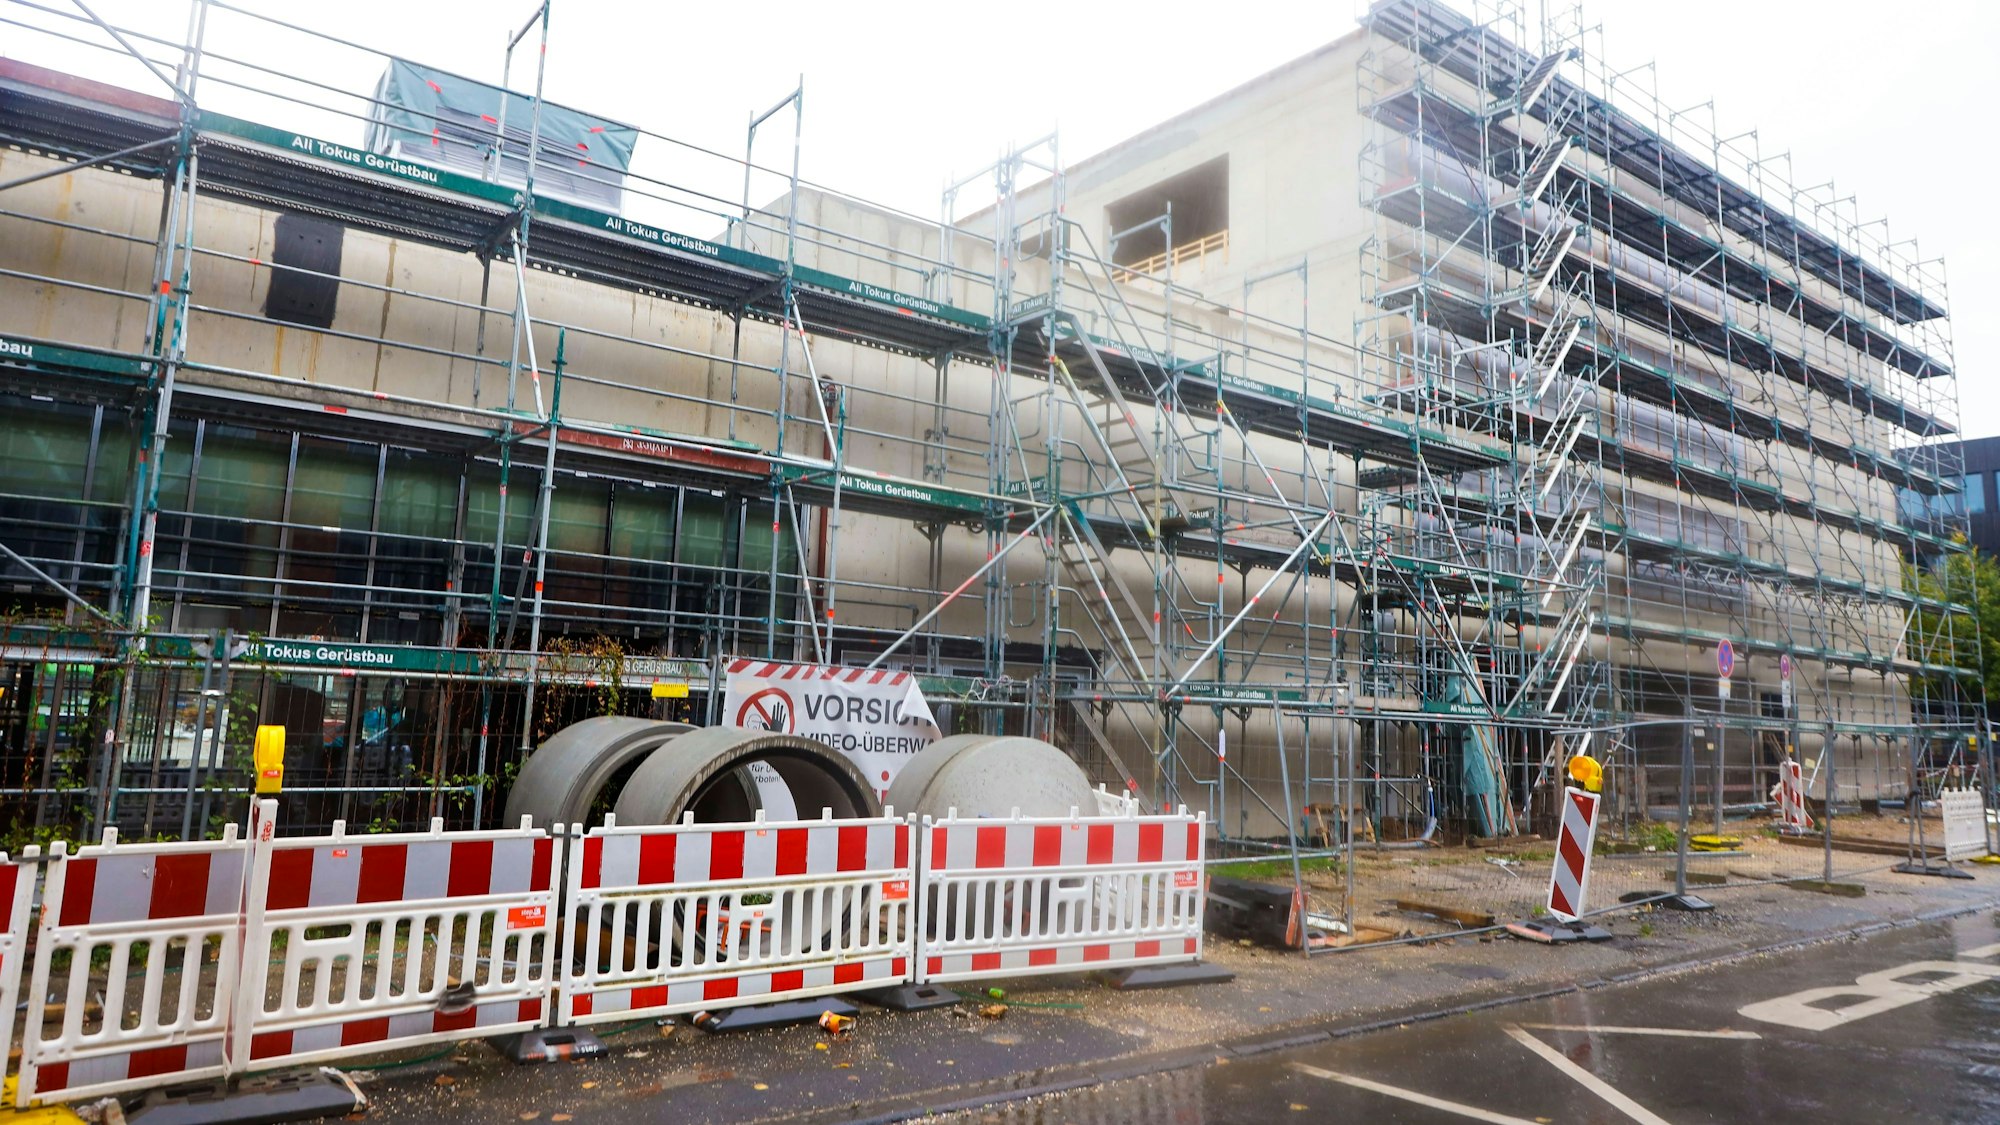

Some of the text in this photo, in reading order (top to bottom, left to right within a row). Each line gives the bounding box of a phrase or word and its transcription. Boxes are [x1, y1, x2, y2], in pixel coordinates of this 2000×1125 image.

[292, 136, 438, 182] Ali Tokus Gerüstbau
[605, 216, 719, 256] Ali Tokus Gerüstbau
[849, 281, 939, 313] Ali Tokus Gerüstbau
[855, 477, 883, 493] Tokus
[885, 484, 932, 501] Gerüstbau
[265, 644, 312, 660] Tokus
[316, 646, 394, 664] Gerüstbau
